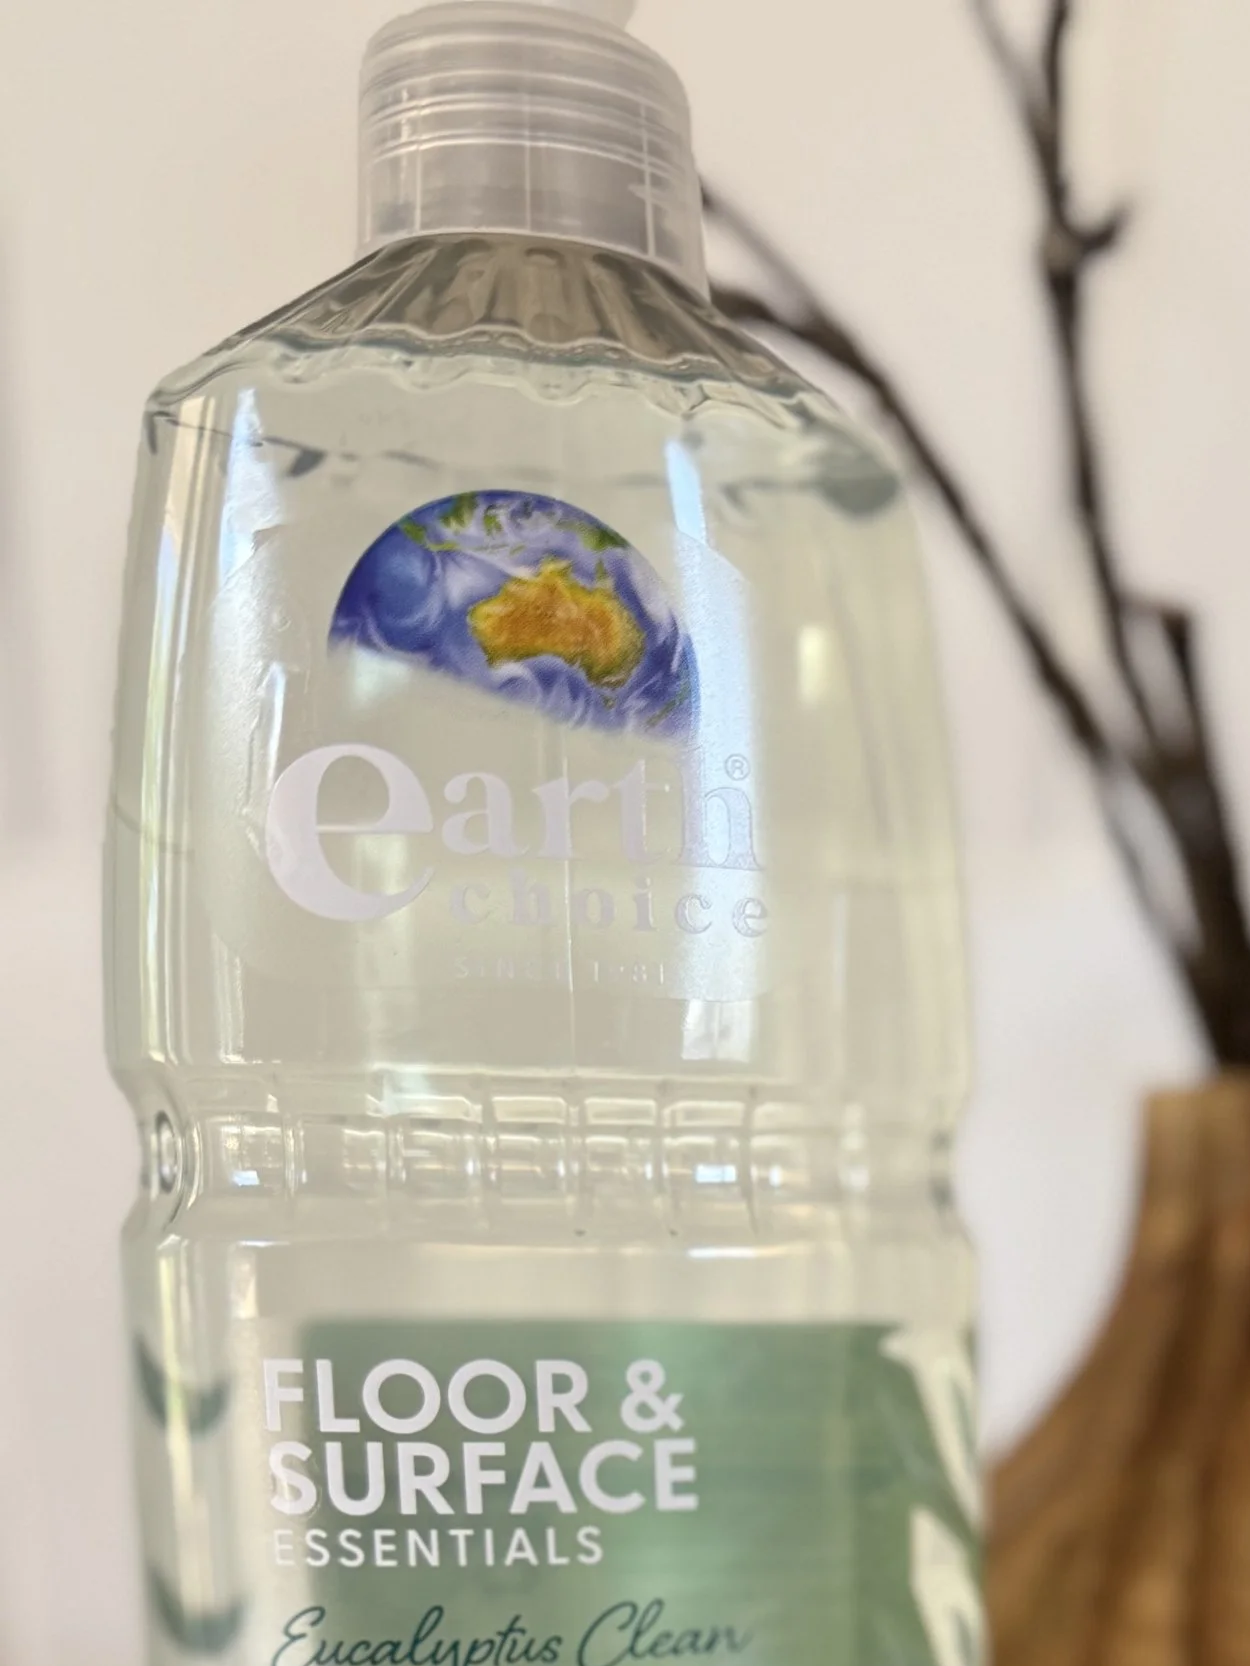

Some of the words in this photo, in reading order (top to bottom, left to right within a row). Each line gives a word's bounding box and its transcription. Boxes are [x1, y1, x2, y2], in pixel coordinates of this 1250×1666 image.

[262, 1358, 593, 1434] FLOOR
[620, 1358, 686, 1433] &
[268, 1437, 700, 1516] SURFACE
[272, 1525, 604, 1568] ESSENTIALS
